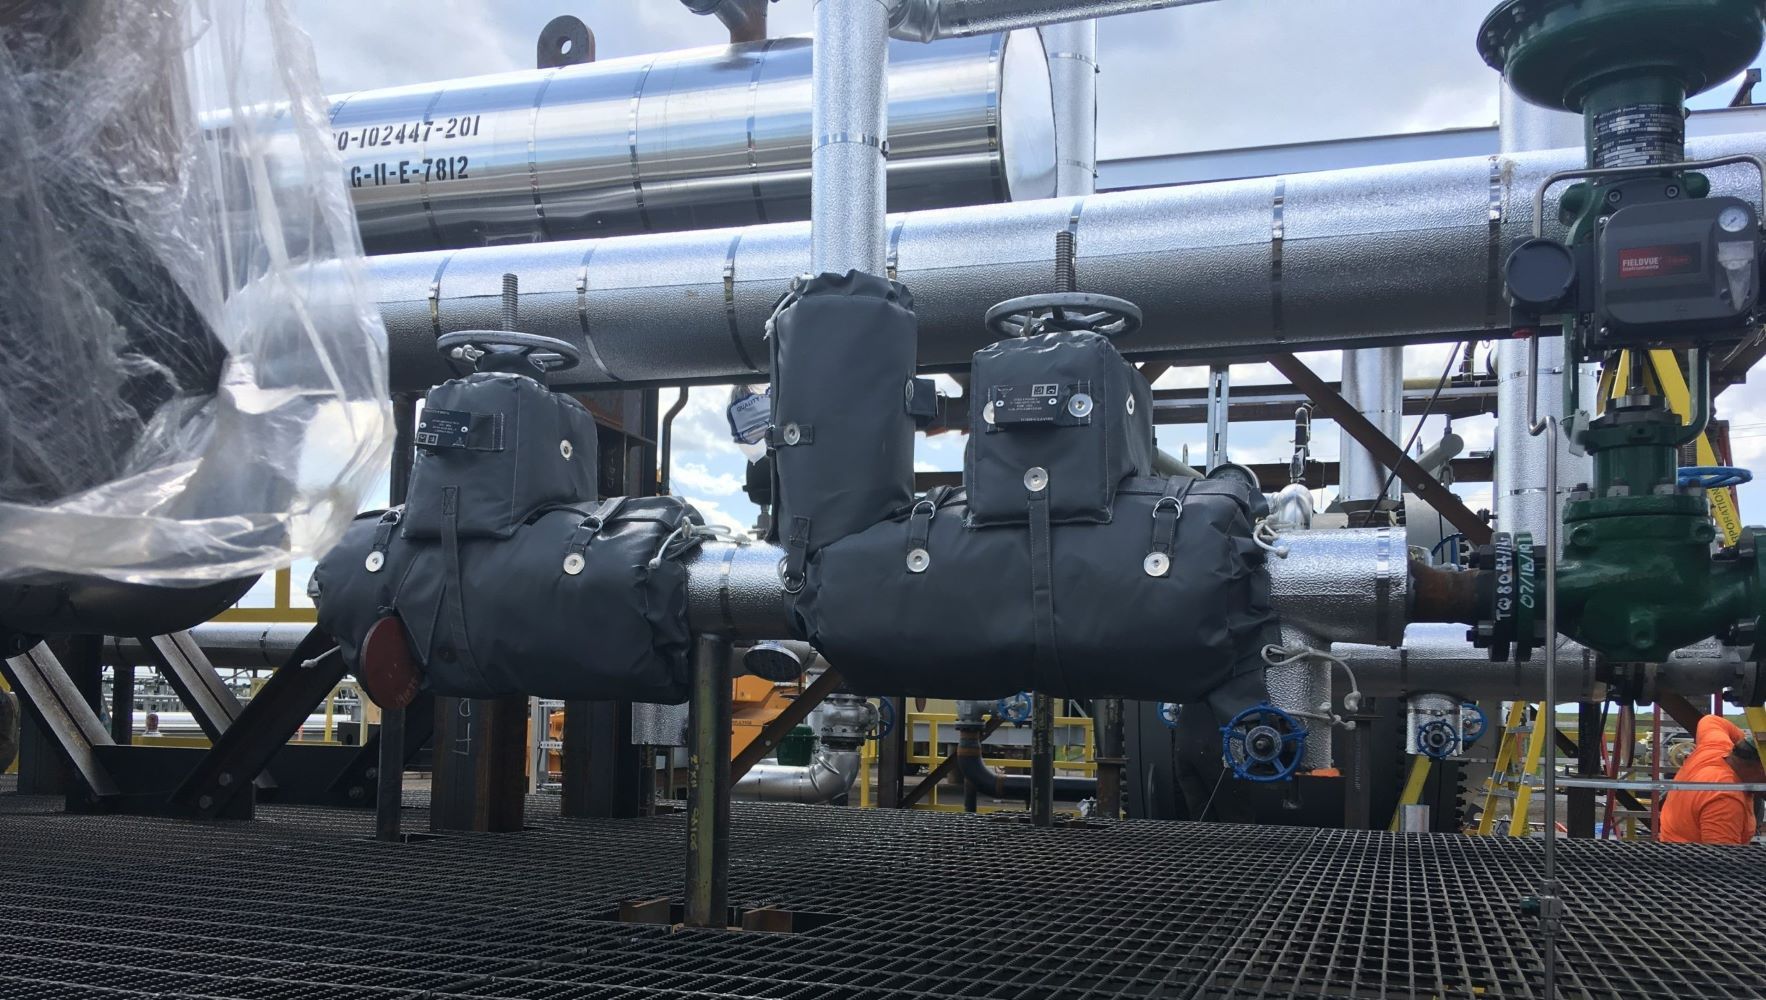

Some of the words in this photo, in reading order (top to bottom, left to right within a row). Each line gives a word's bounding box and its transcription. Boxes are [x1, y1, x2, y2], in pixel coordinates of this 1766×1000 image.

[333, 115, 480, 151] 0-102447-201
[351, 156, 468, 187] G-11-E-7812
[1623, 257, 1659, 267] FIELDVUE
[1496, 597, 1512, 621] TQ
